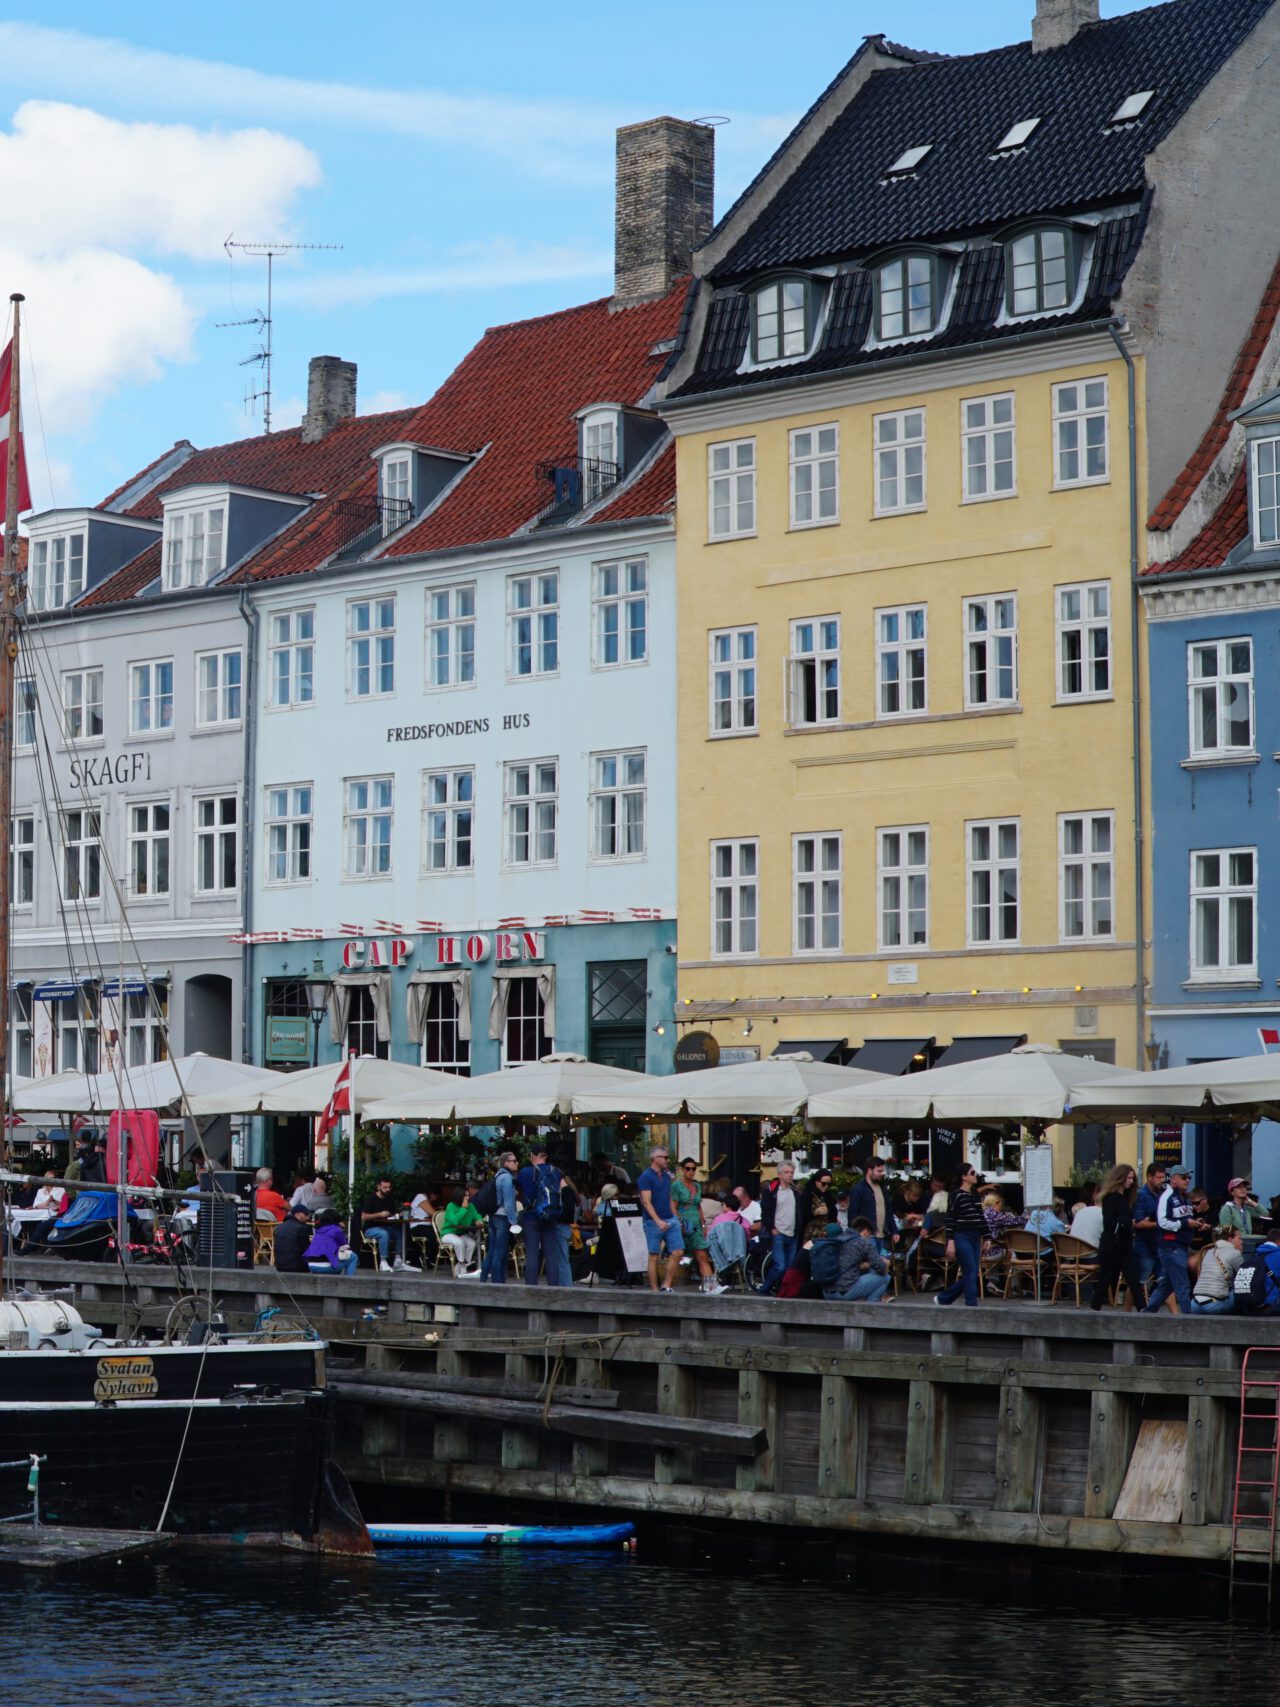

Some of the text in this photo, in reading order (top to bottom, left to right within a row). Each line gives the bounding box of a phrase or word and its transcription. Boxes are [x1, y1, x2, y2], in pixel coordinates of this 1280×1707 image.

[387, 713, 530, 742] FREDSFONDENS HUS
[343, 932, 546, 968] CAP HORN
[99, 1360, 152, 1375] Svalan
[96, 1380, 154, 1398] Nyhavn
